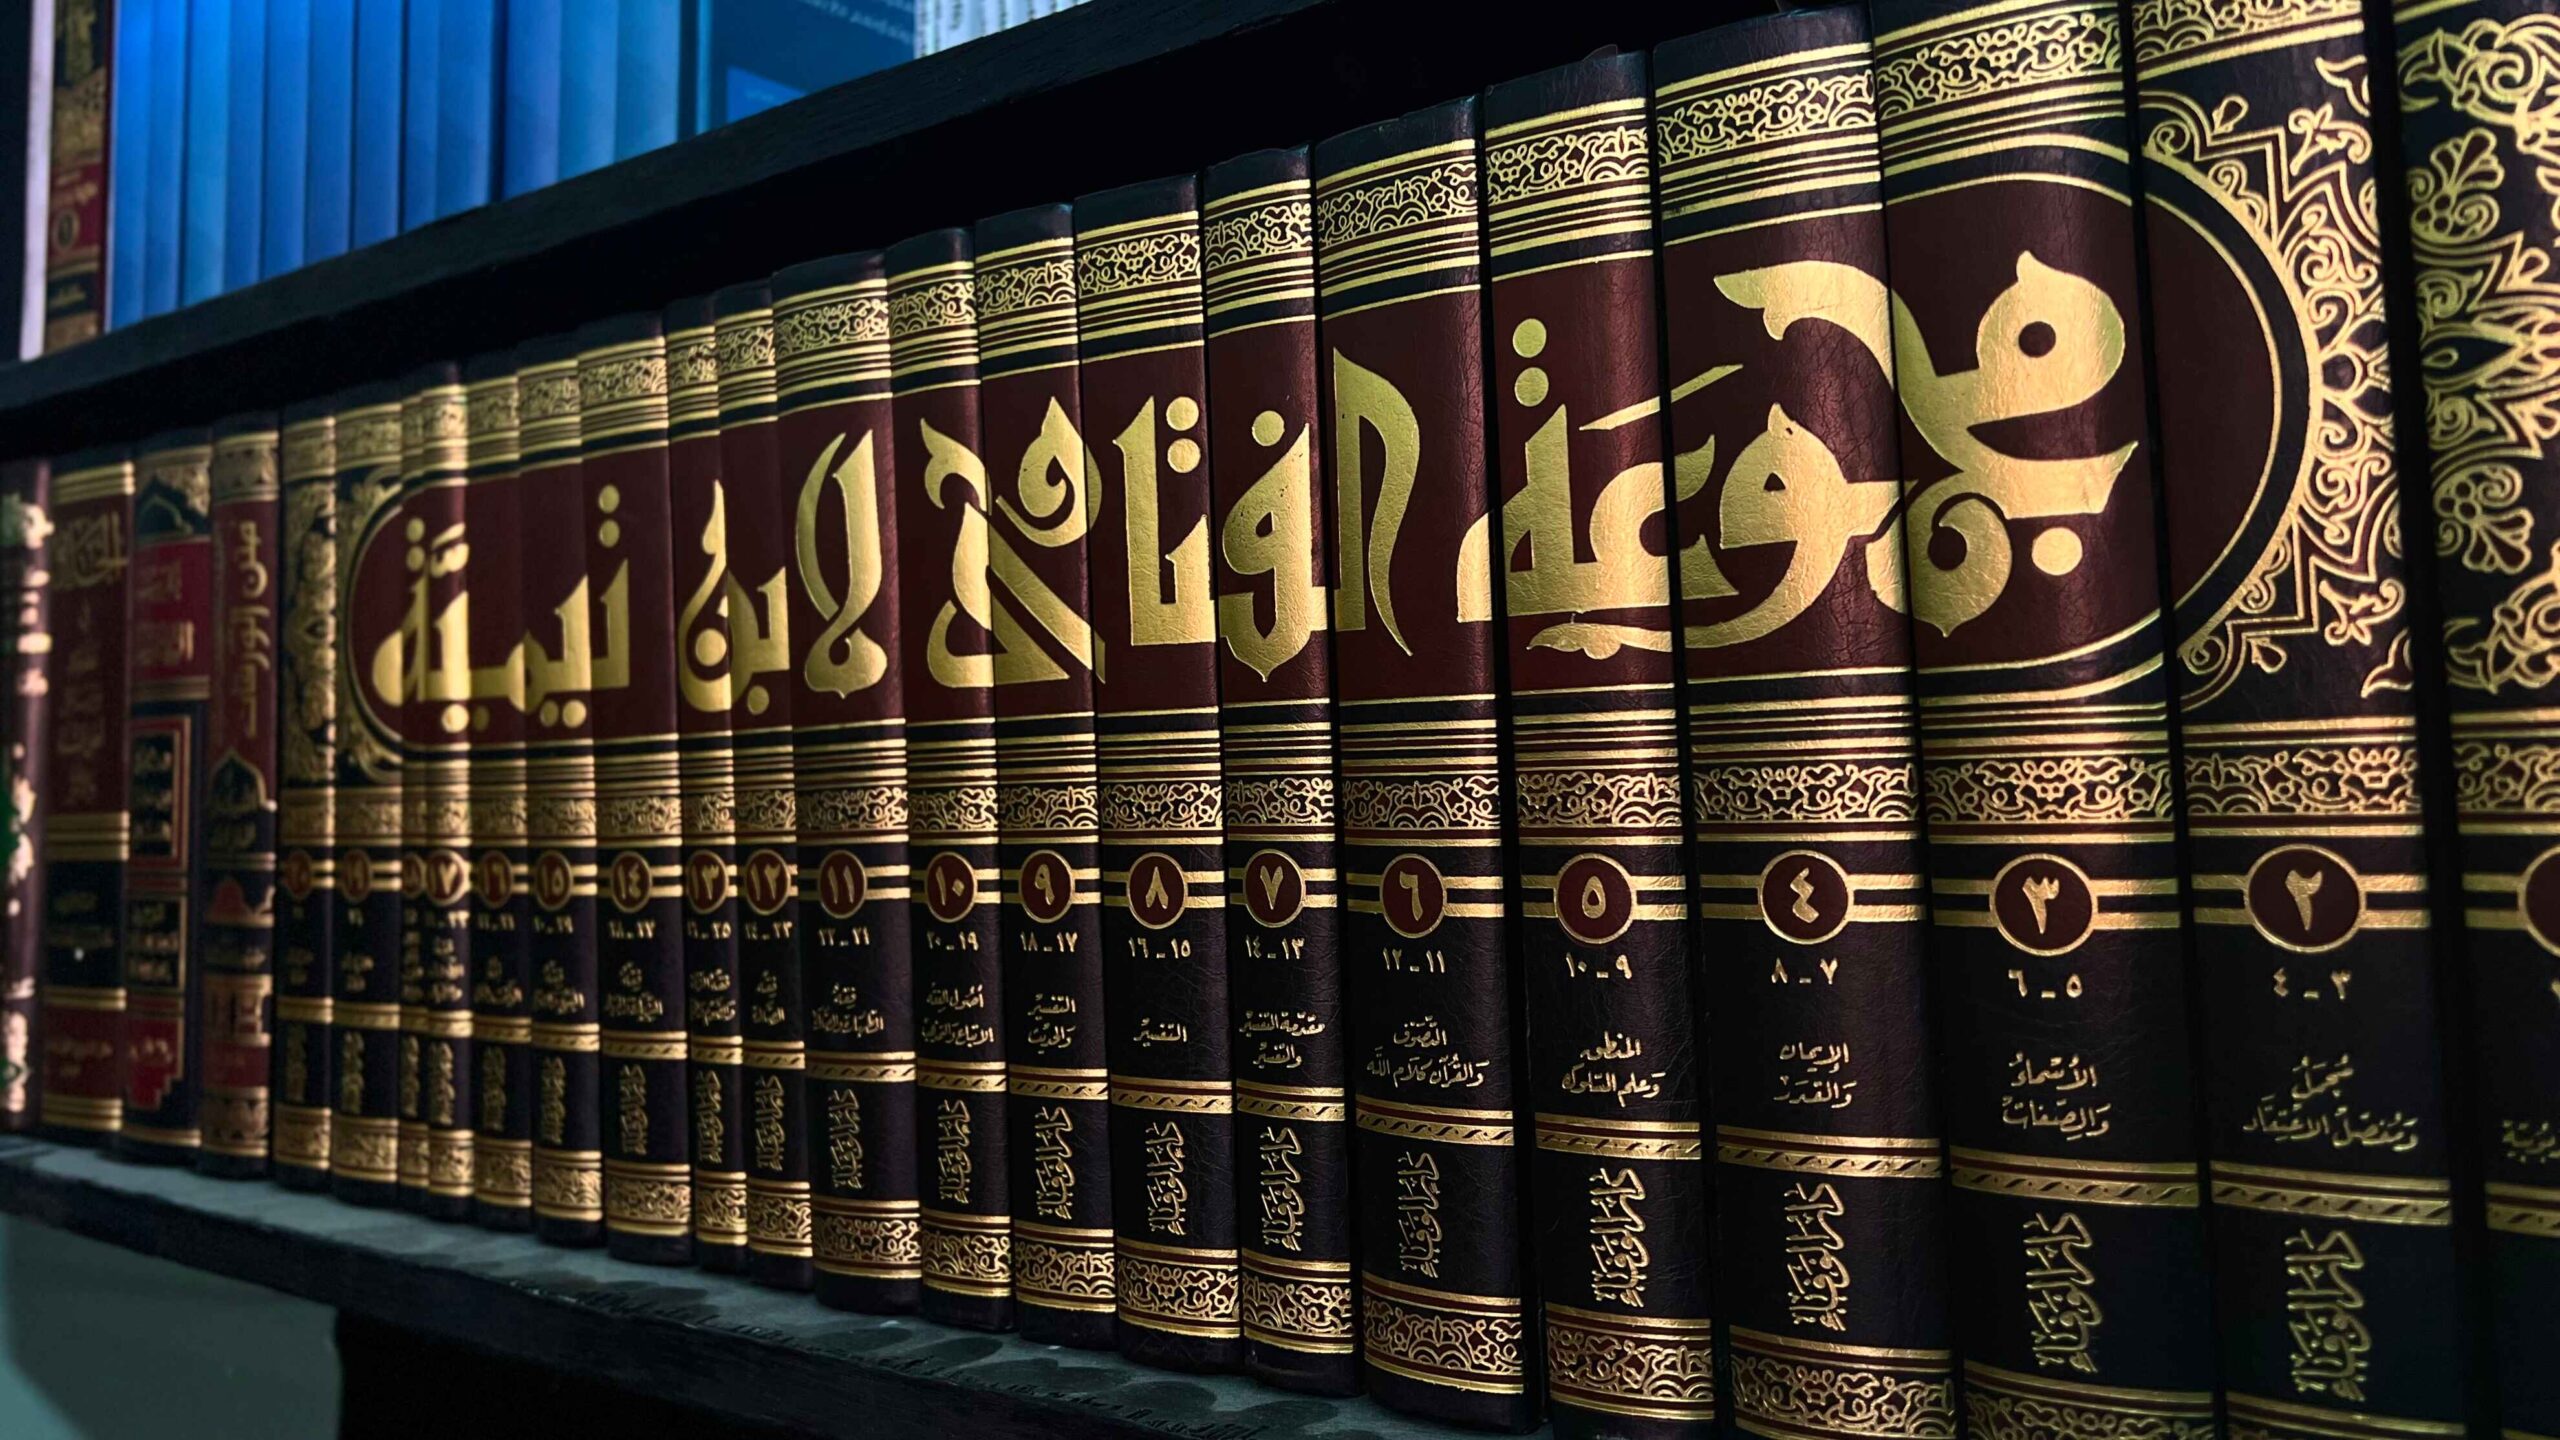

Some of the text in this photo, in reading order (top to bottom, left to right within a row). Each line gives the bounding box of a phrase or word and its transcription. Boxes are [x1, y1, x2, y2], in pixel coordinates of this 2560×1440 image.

[617, 863, 643, 901] ١٤
[692, 862, 720, 900] ١٣
[749, 862, 779, 902] ١٢
[828, 865, 857, 906] ١١
[934, 865, 966, 907] ١٠
[1034, 864, 1056, 906] ٩
[1145, 866, 1169, 910] ٨
[1259, 865, 1284, 911] ٧
[1399, 873, 1422, 921] ٦
[1581, 875, 1607, 919] ٥
[1789, 867, 1820, 924] ٤
[2285, 870, 2323, 931] ٢
[2022, 876, 2060, 935] ٣
[1027, 993, 1076, 1018] التفسير
[1027, 1022, 1076, 1054] والحديث
[1133, 1016, 1188, 1047] التفسير
[1392, 1016, 1448, 1047] التصوف
[1253, 1042, 1303, 1069] والتفسير
[1366, 1046, 1391, 1079] الله
[2290, 1054, 2355, 1099] مجمل
[1561, 1064, 1667, 1108] وعلم السلوك
[1773, 1075, 1858, 1109] والقدر
[2001, 1095, 2113, 1140] والصفات
